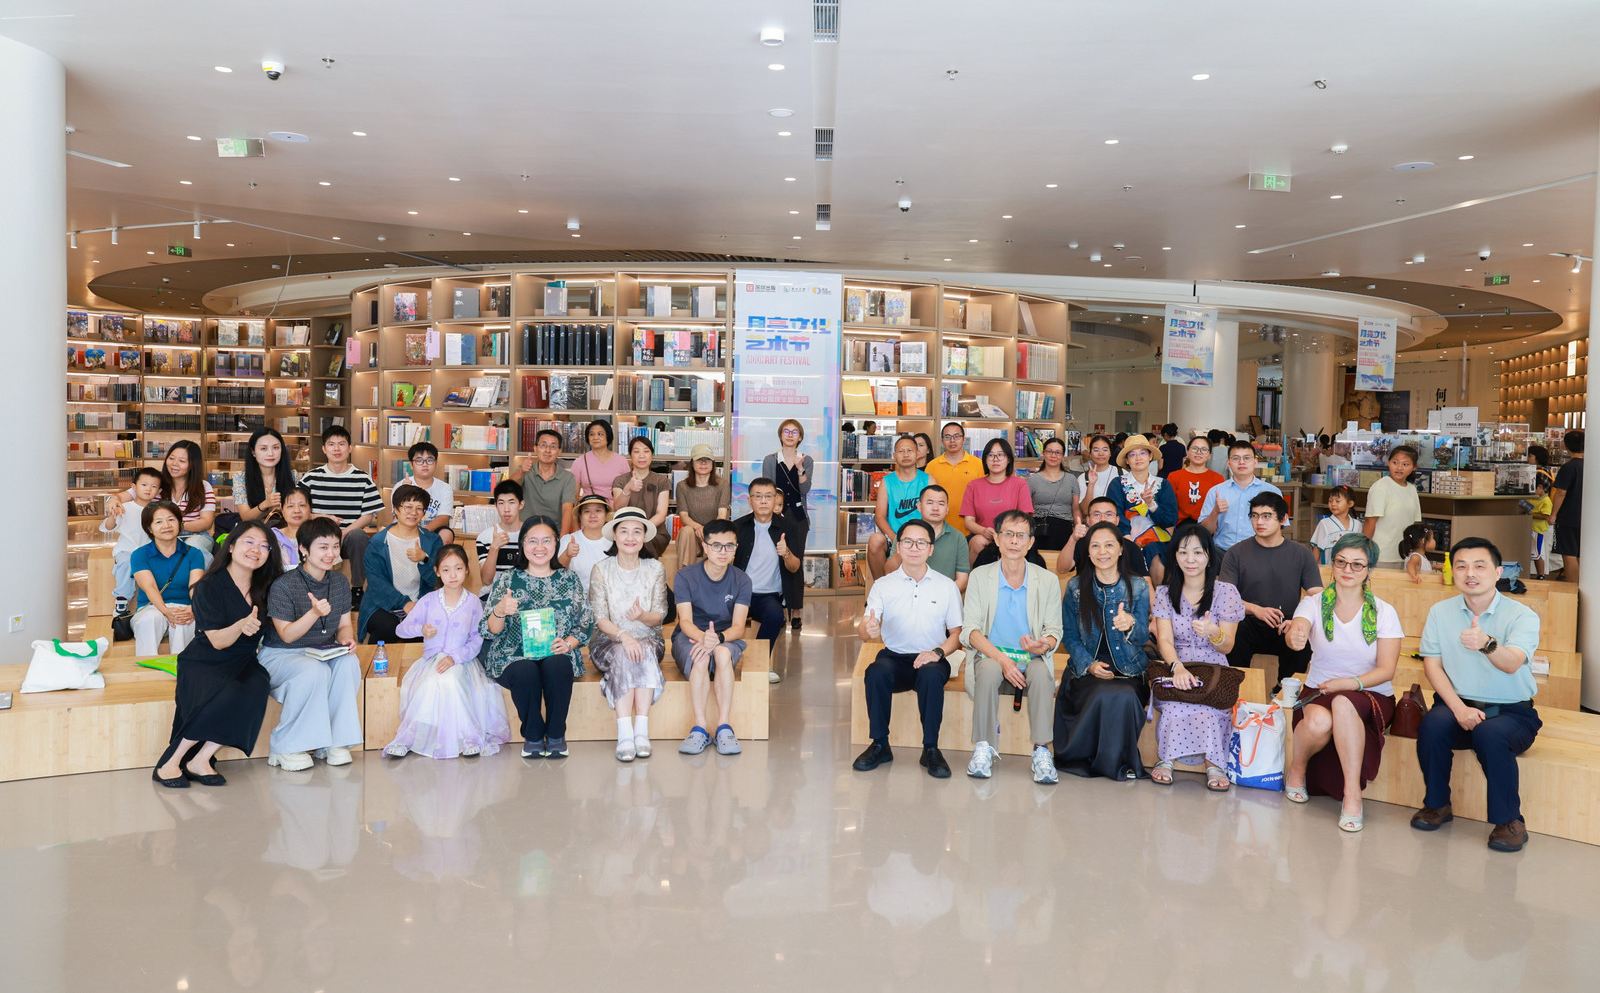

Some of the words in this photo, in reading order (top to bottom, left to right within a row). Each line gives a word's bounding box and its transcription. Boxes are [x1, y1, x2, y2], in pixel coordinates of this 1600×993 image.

[746, 316, 831, 334] 月亮文化
[1170, 318, 1206, 330] 月亮文化
[1169, 328, 1196, 338] 艺术节
[1360, 329, 1388, 339] 月亮文化
[745, 335, 810, 351] 艺术节
[1360, 338, 1380, 347] 艺术节
[764, 355, 778, 365] ART
[780, 356, 811, 366] FESTIVAL
[898, 497, 919, 510] NIKE
